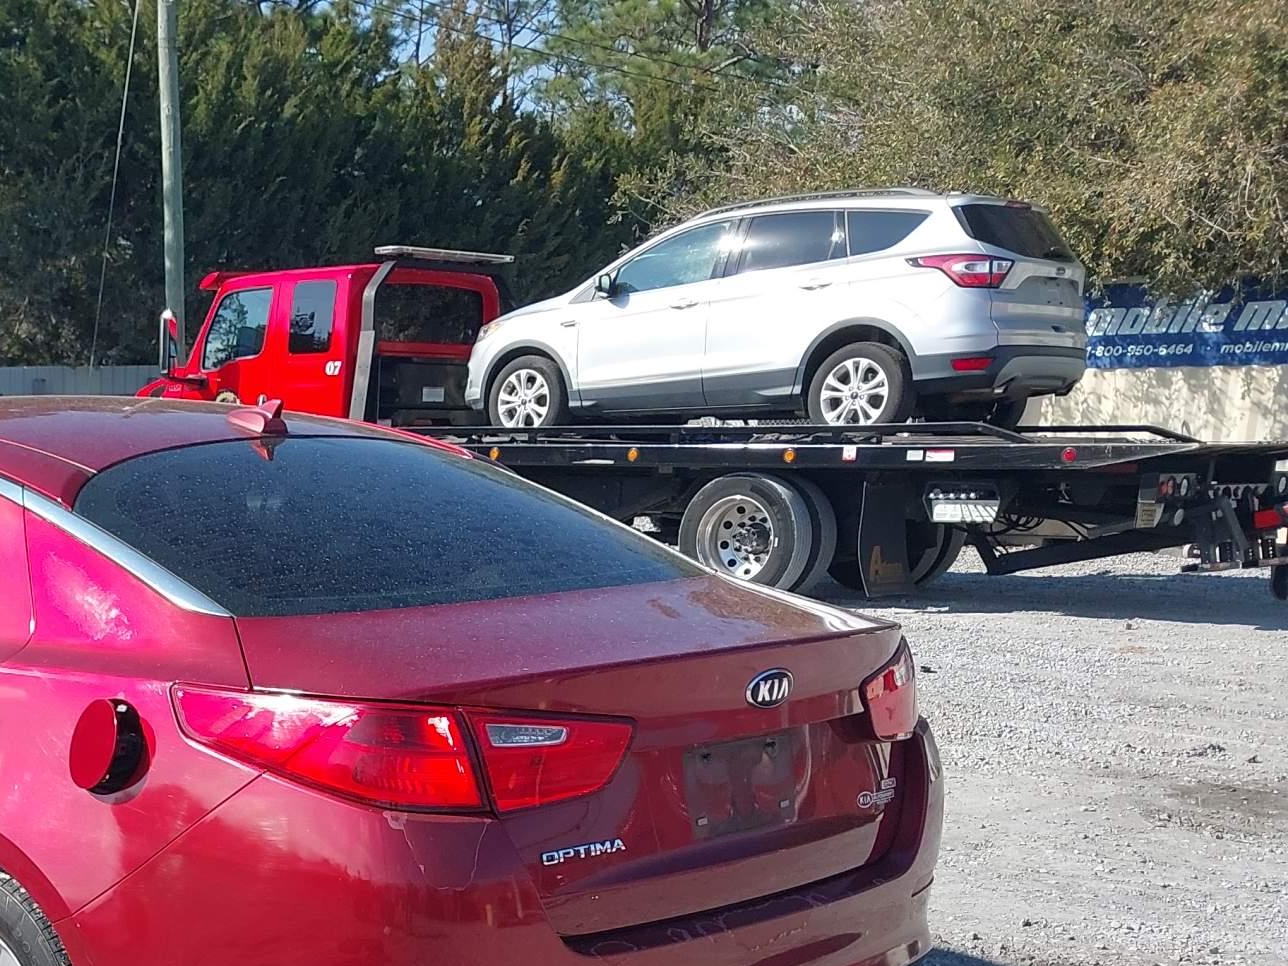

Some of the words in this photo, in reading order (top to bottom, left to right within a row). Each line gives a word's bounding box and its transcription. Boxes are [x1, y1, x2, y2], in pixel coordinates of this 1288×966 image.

[1085, 297, 1232, 336] mobile
[1086, 344, 1194, 357] 1-800-950-6464
[325, 360, 342, 376] 07
[757, 677, 789, 702] KIA
[541, 838, 626, 866] OPTIMA
